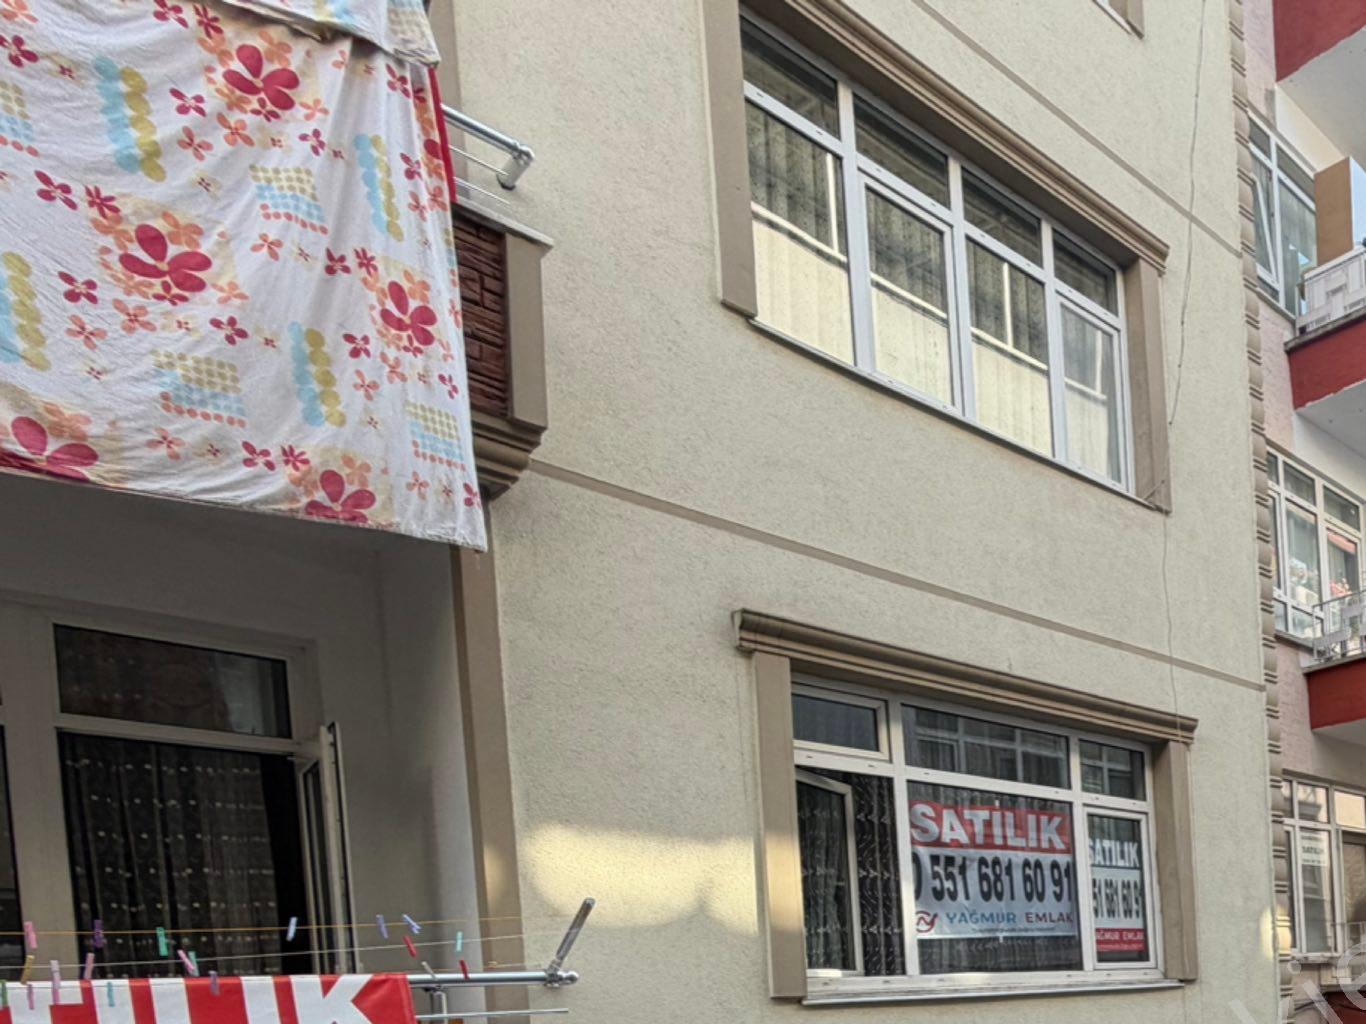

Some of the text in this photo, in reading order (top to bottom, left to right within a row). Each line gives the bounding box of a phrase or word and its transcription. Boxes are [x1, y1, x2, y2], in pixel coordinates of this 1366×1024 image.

[930, 854, 970, 902] 551
[977, 856, 1016, 903] 681
[1022, 858, 1046, 903] 60
[1050, 859, 1073, 903] 91
[945, 909, 1073, 925] YAĞMUR EMLAK
